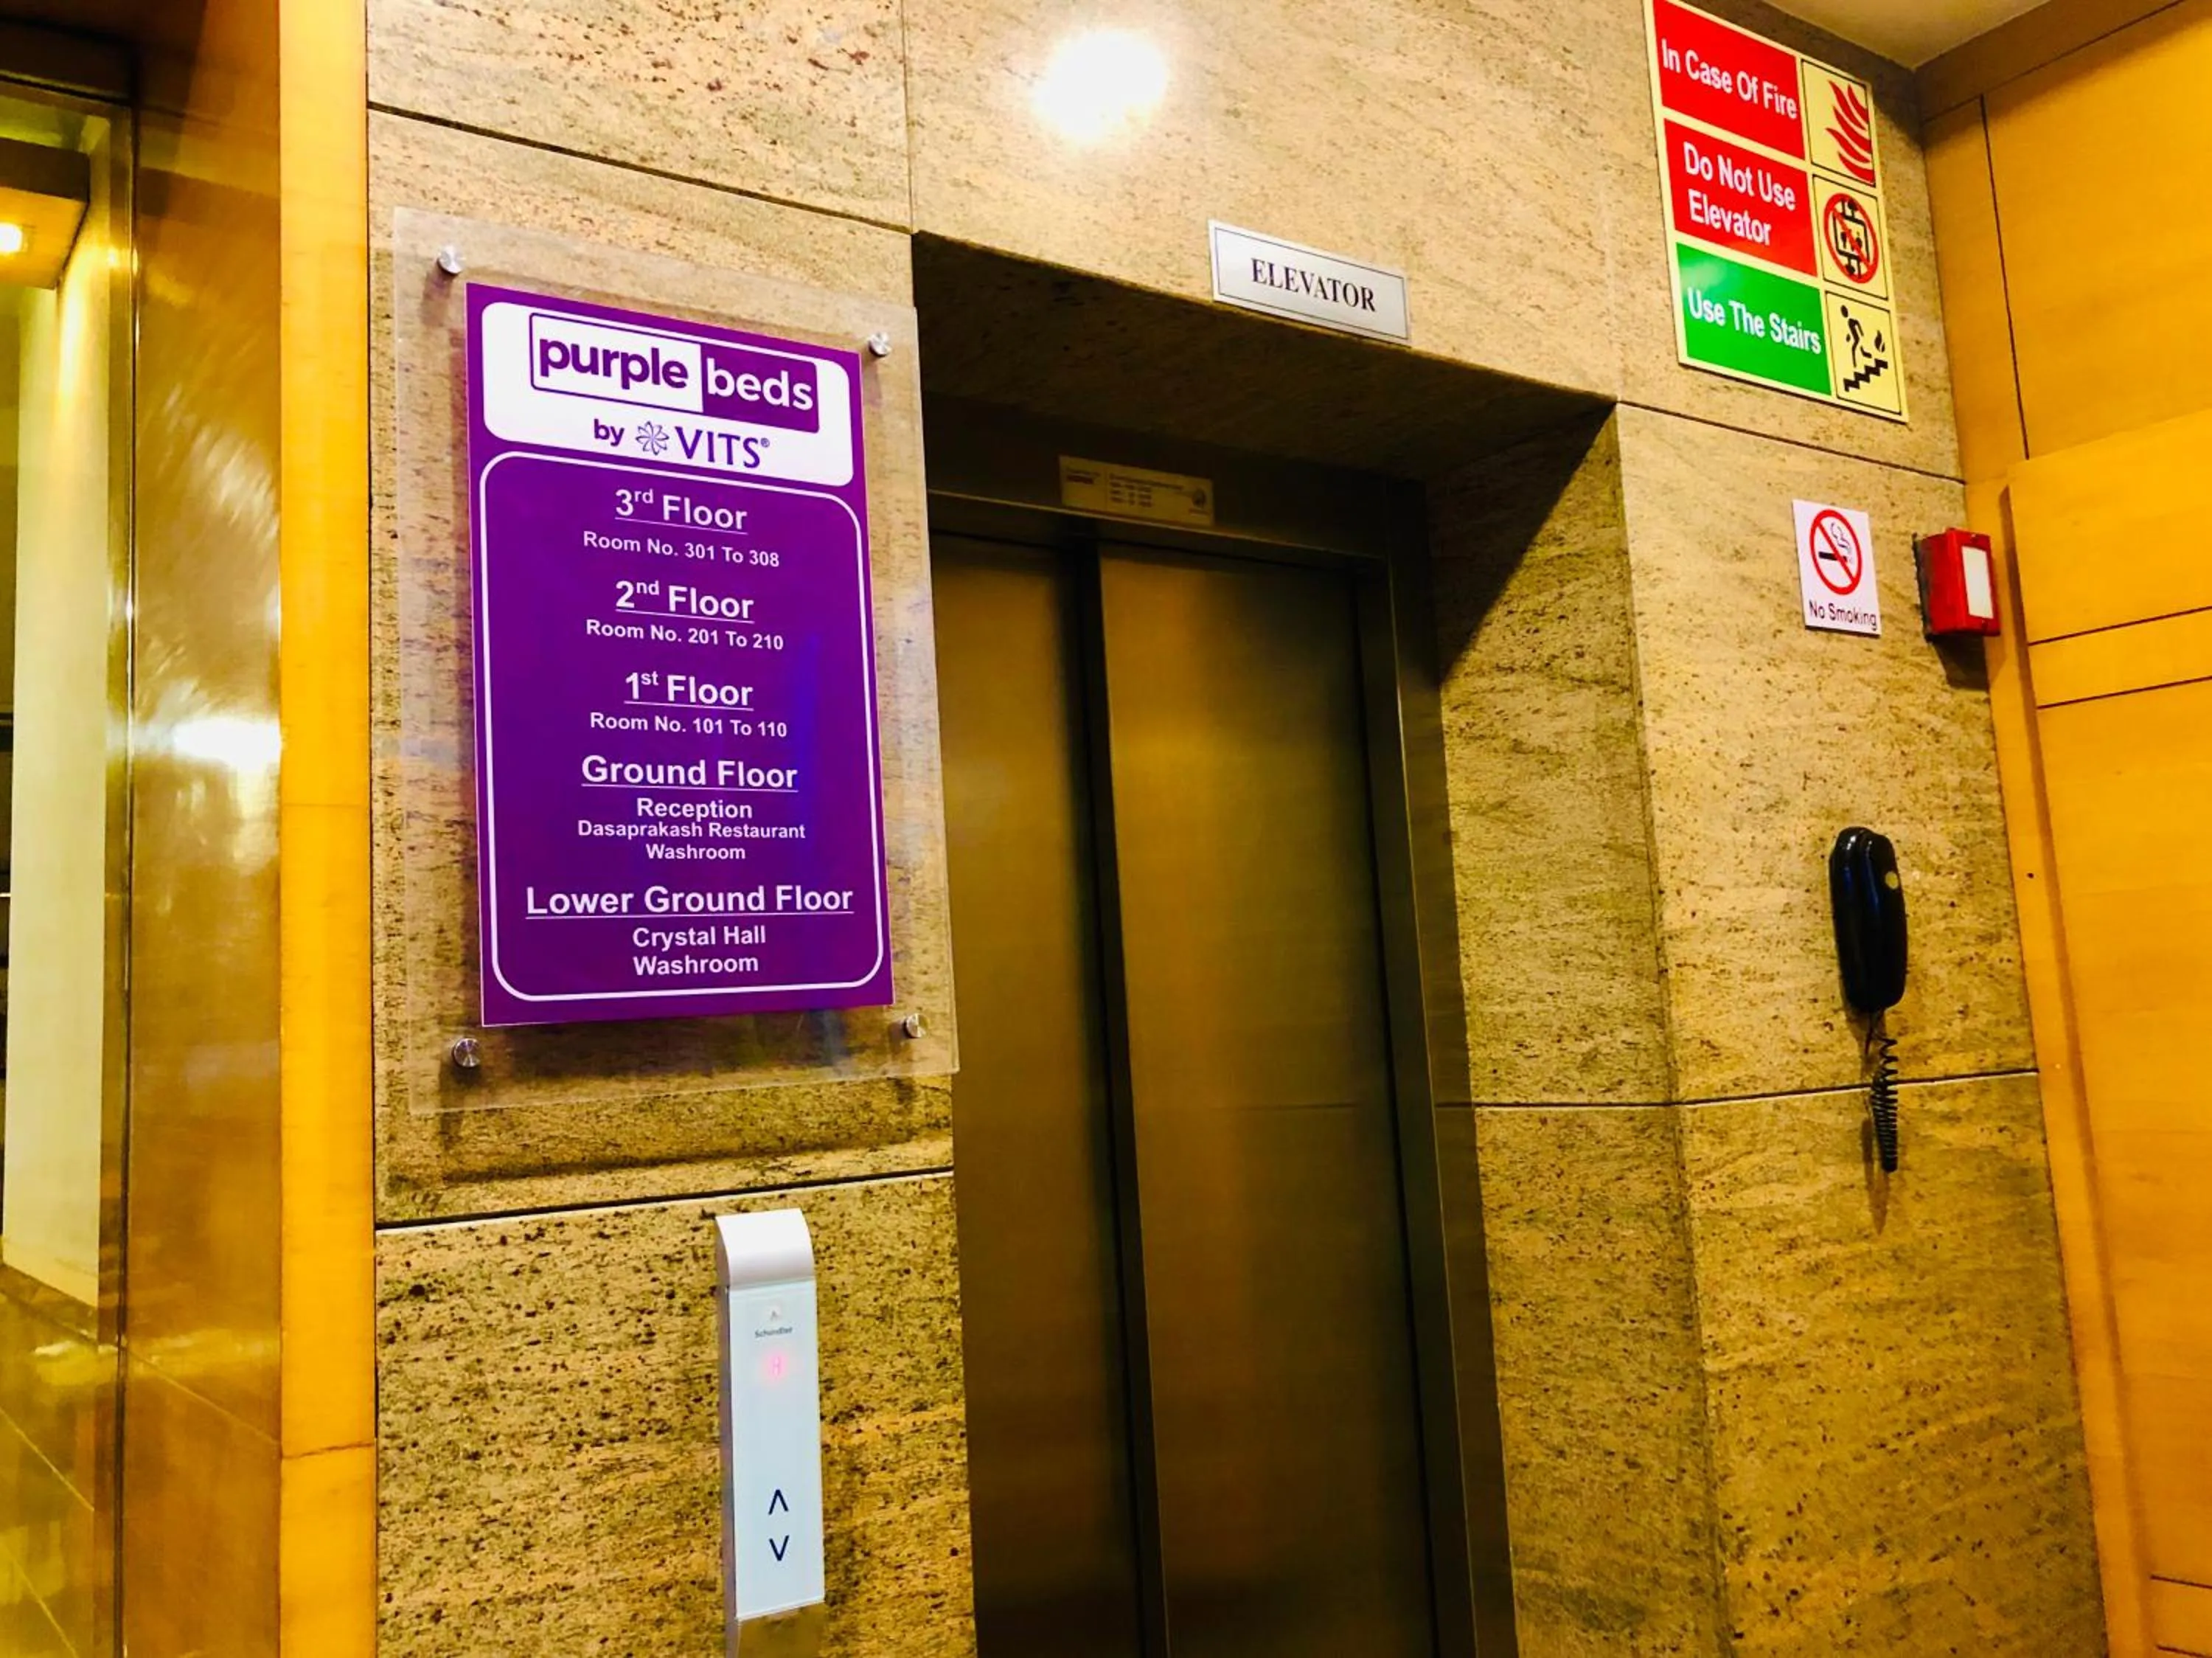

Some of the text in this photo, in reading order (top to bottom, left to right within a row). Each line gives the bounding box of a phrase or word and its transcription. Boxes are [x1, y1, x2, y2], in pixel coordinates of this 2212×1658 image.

[1661, 38, 1798, 119] In Case Of Fire
[1683, 142, 1796, 210] Do Not Use
[1688, 190, 1772, 246] Elevator
[1251, 257, 1376, 312] ELEVATOR
[1687, 288, 1821, 354] Use The Stairs
[539, 338, 813, 411] purple beds
[593, 419, 625, 446] by
[663, 494, 748, 530] Floor
[582, 530, 780, 567] Room No. 301 To 308
[668, 585, 754, 619] Floor
[1809, 600, 1877, 631] No Smoking
[586, 619, 784, 651] Room No. 201 To 210
[667, 675, 754, 707] Floor
[590, 712, 787, 738] Room No. 101 To 110
[581, 755, 798, 788] Ground Floor
[636, 797, 753, 822] Reception
[577, 820, 806, 839] Dasaprakash Restaurant
[645, 844, 746, 861] Washroom
[526, 885, 854, 915] Lower Ground Floor
[632, 925, 766, 951] Crystal Hall
[633, 955, 759, 976] Washroom
